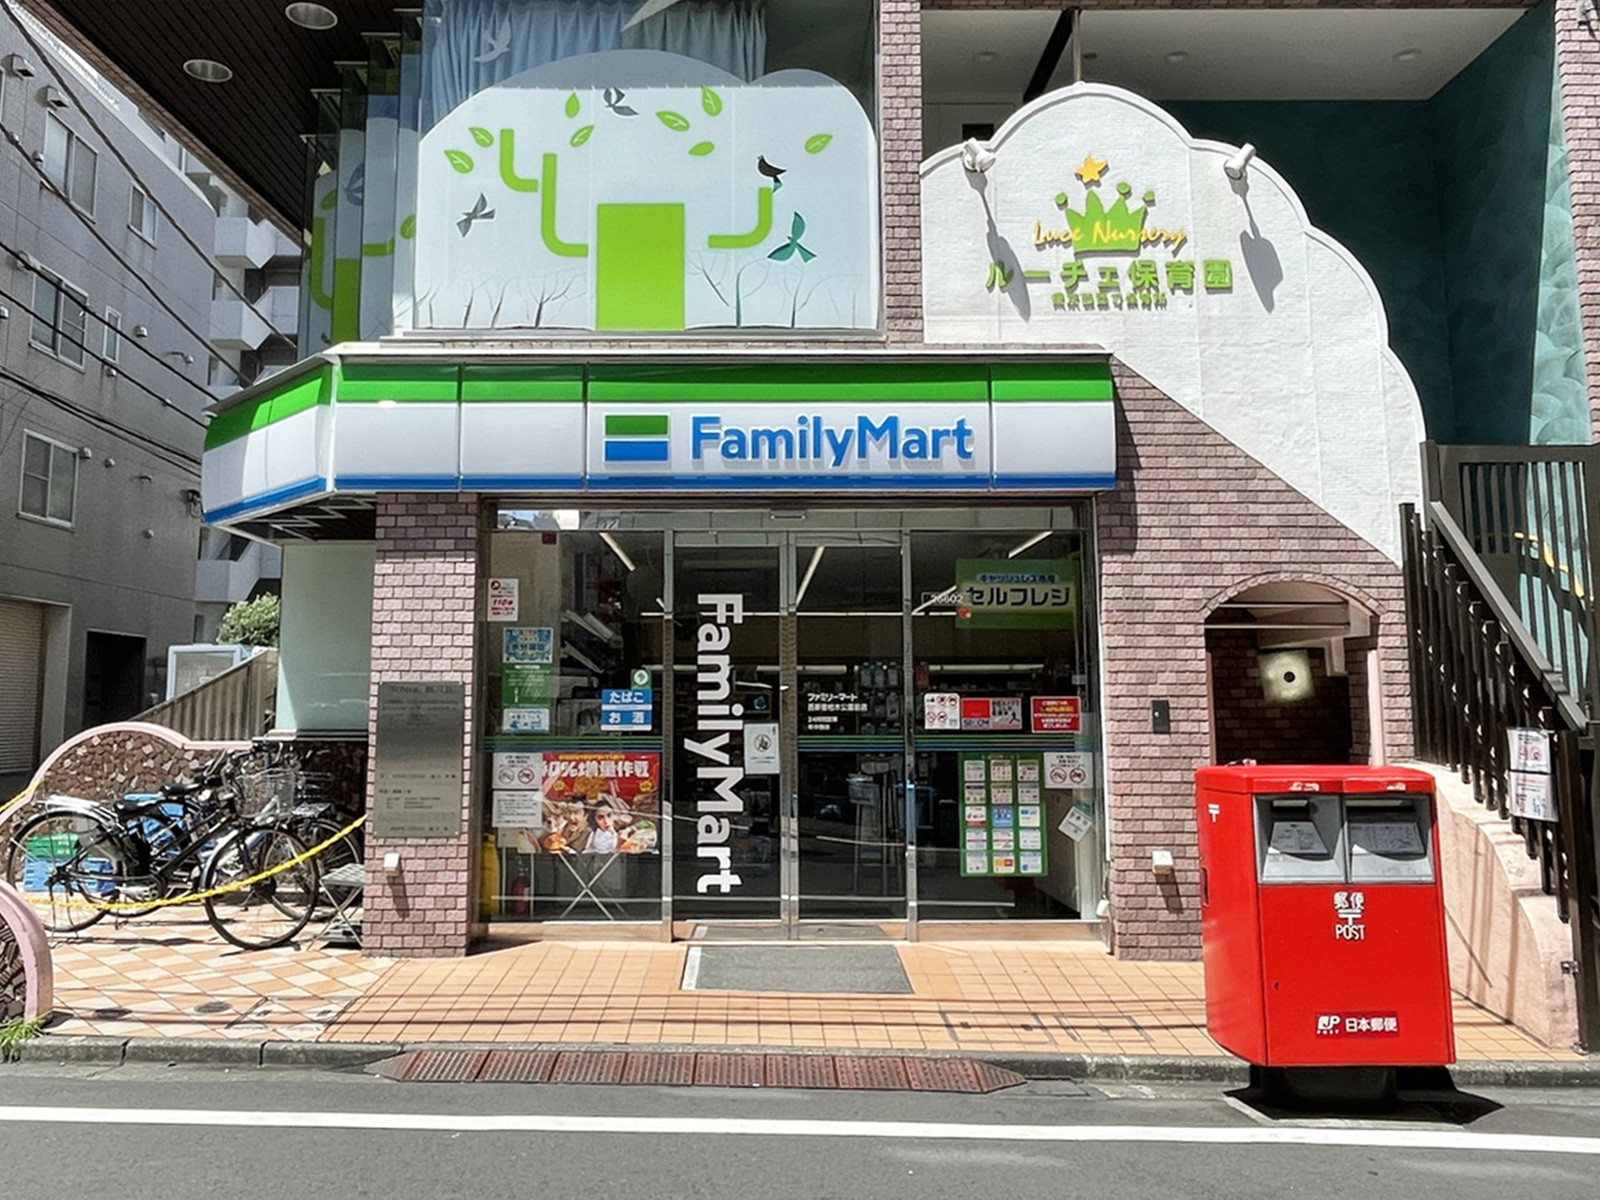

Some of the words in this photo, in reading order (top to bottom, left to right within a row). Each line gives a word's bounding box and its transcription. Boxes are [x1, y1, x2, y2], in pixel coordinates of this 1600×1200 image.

[1033, 219, 1083, 245] Luce
[1092, 221, 1187, 248] Nursery
[985, 259, 1232, 288] ルーチェ保育園
[691, 414, 974, 468] FamilyMart
[966, 587, 1071, 606] セルフレジ
[609, 690, 644, 704] たばこ
[807, 693, 858, 702] ファミリーマート
[609, 711, 645, 724] お酒
[684, 593, 744, 893] FamilyMart
[1333, 891, 1365, 909] 郵便
[1335, 924, 1366, 940] POST
[1345, 1017, 1398, 1032] 日本郵便
